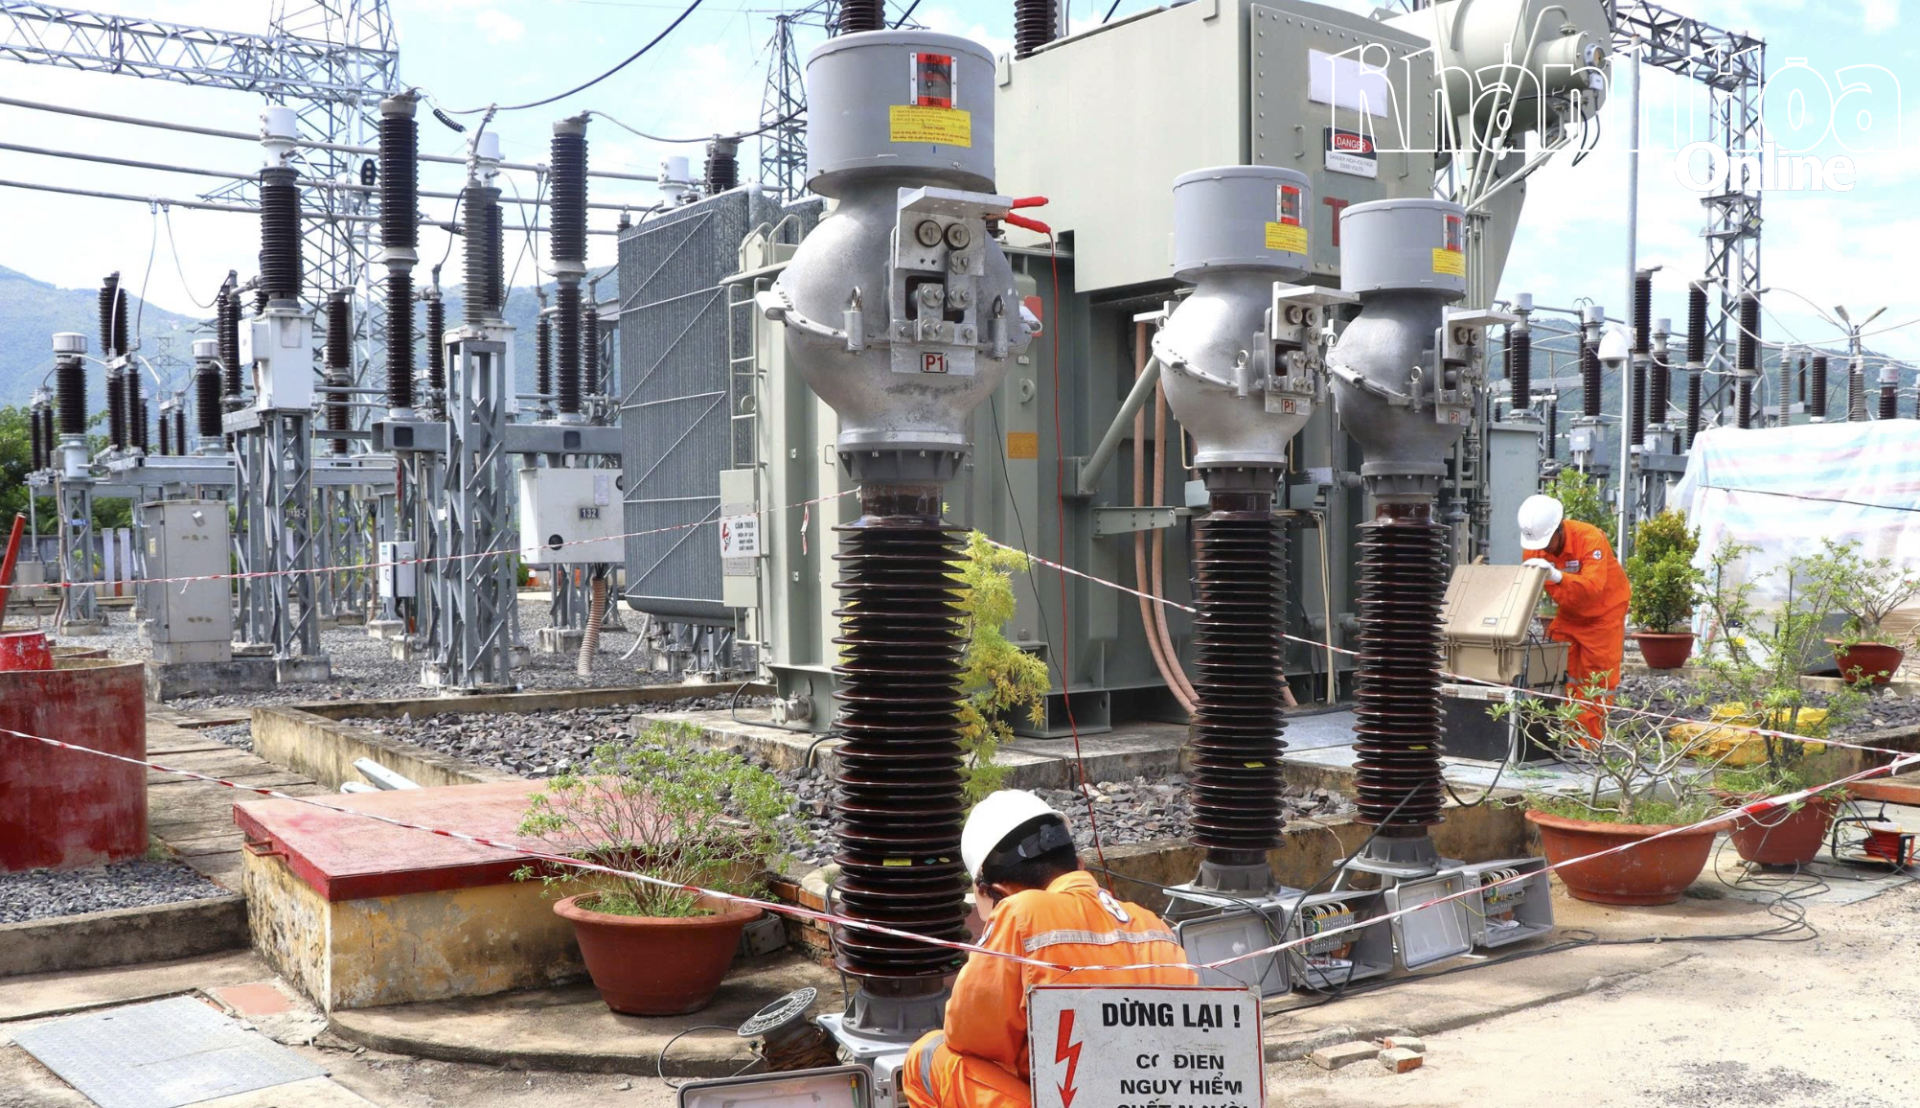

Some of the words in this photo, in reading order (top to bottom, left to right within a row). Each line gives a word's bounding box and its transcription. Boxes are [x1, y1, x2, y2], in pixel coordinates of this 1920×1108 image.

[1336, 136, 1367, 151] DANGER
[925, 355, 944, 371] P1
[1284, 401, 1294, 412] P1
[1450, 413, 1459, 422] P1
[582, 509, 597, 518] 132
[1102, 997, 1174, 1027] DỪNG
[1182, 1003, 1223, 1032] LẠI
[1234, 1004, 1241, 1028] !
[1120, 1079, 1182, 1095] NGUY
[1190, 1071, 1242, 1095] HIỂM
